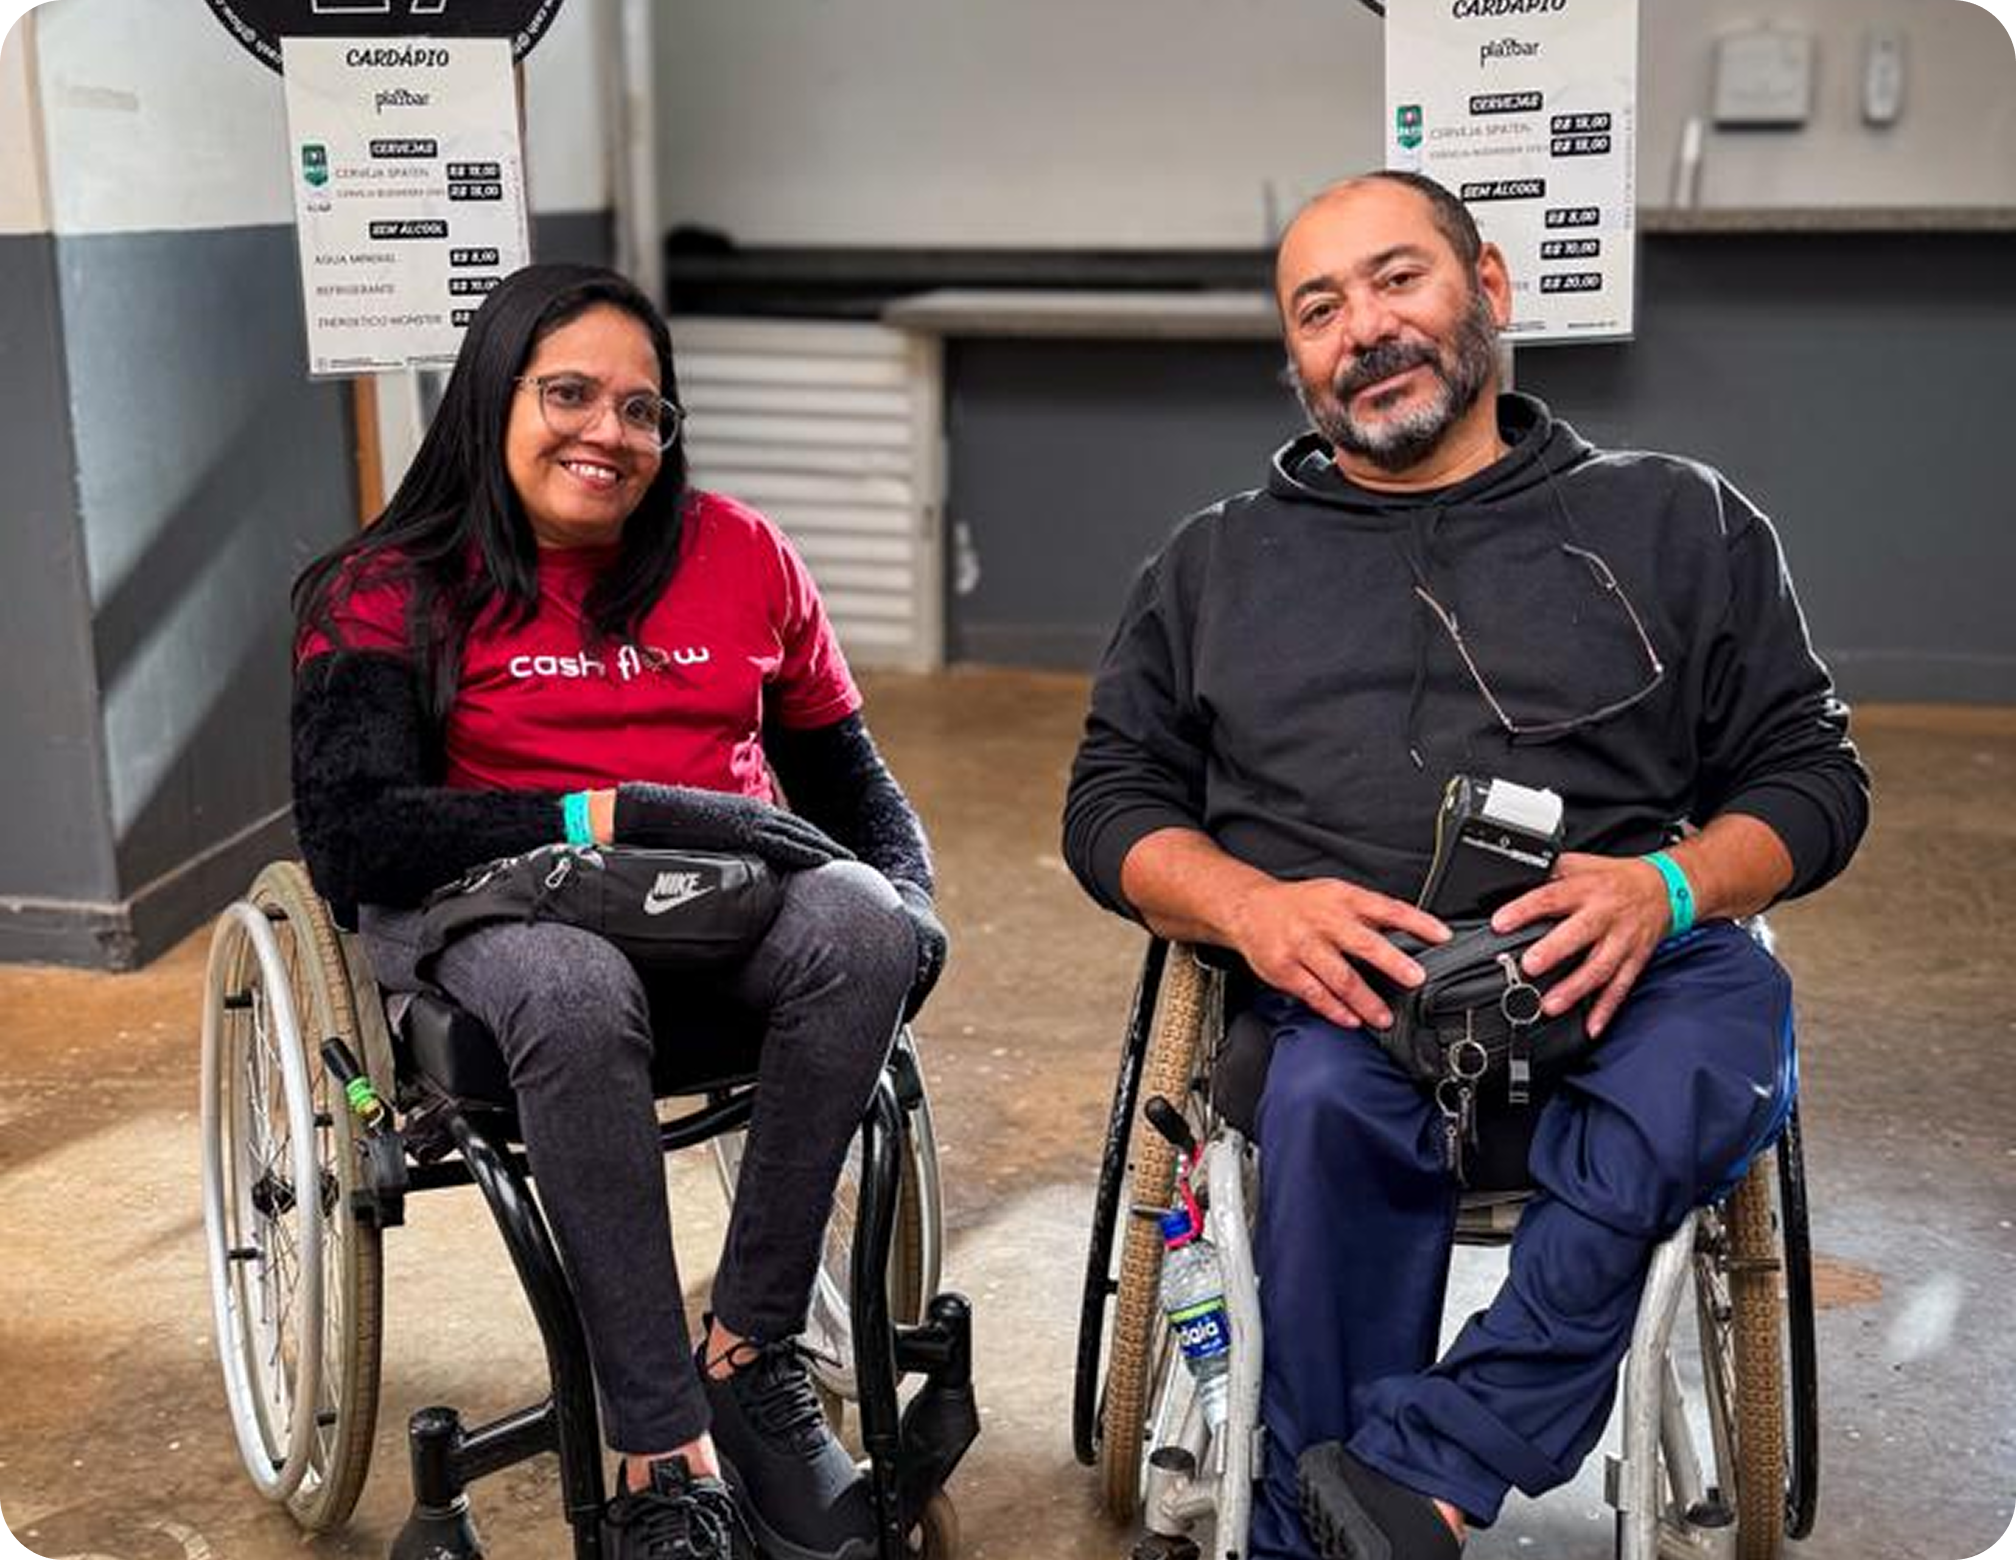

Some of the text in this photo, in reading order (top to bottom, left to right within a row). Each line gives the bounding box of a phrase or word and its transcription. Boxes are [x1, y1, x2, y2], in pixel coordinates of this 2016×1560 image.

[346, 44, 449, 67] CARDÁPIO
[1471, 94, 1540, 111] CERVEJAS
[1553, 117, 1572, 130] R$
[371, 143, 434, 154] CERVEJAS
[1553, 139, 1572, 152] R$
[450, 185, 468, 198] R$
[1547, 210, 1566, 225] R$
[1543, 243, 1562, 256] R$
[453, 251, 469, 263] R$
[452, 280, 468, 292] R$
[1543, 277, 1561, 290] R$
[510, 651, 605, 678] cash
[653, 871, 702, 896] NIKE
